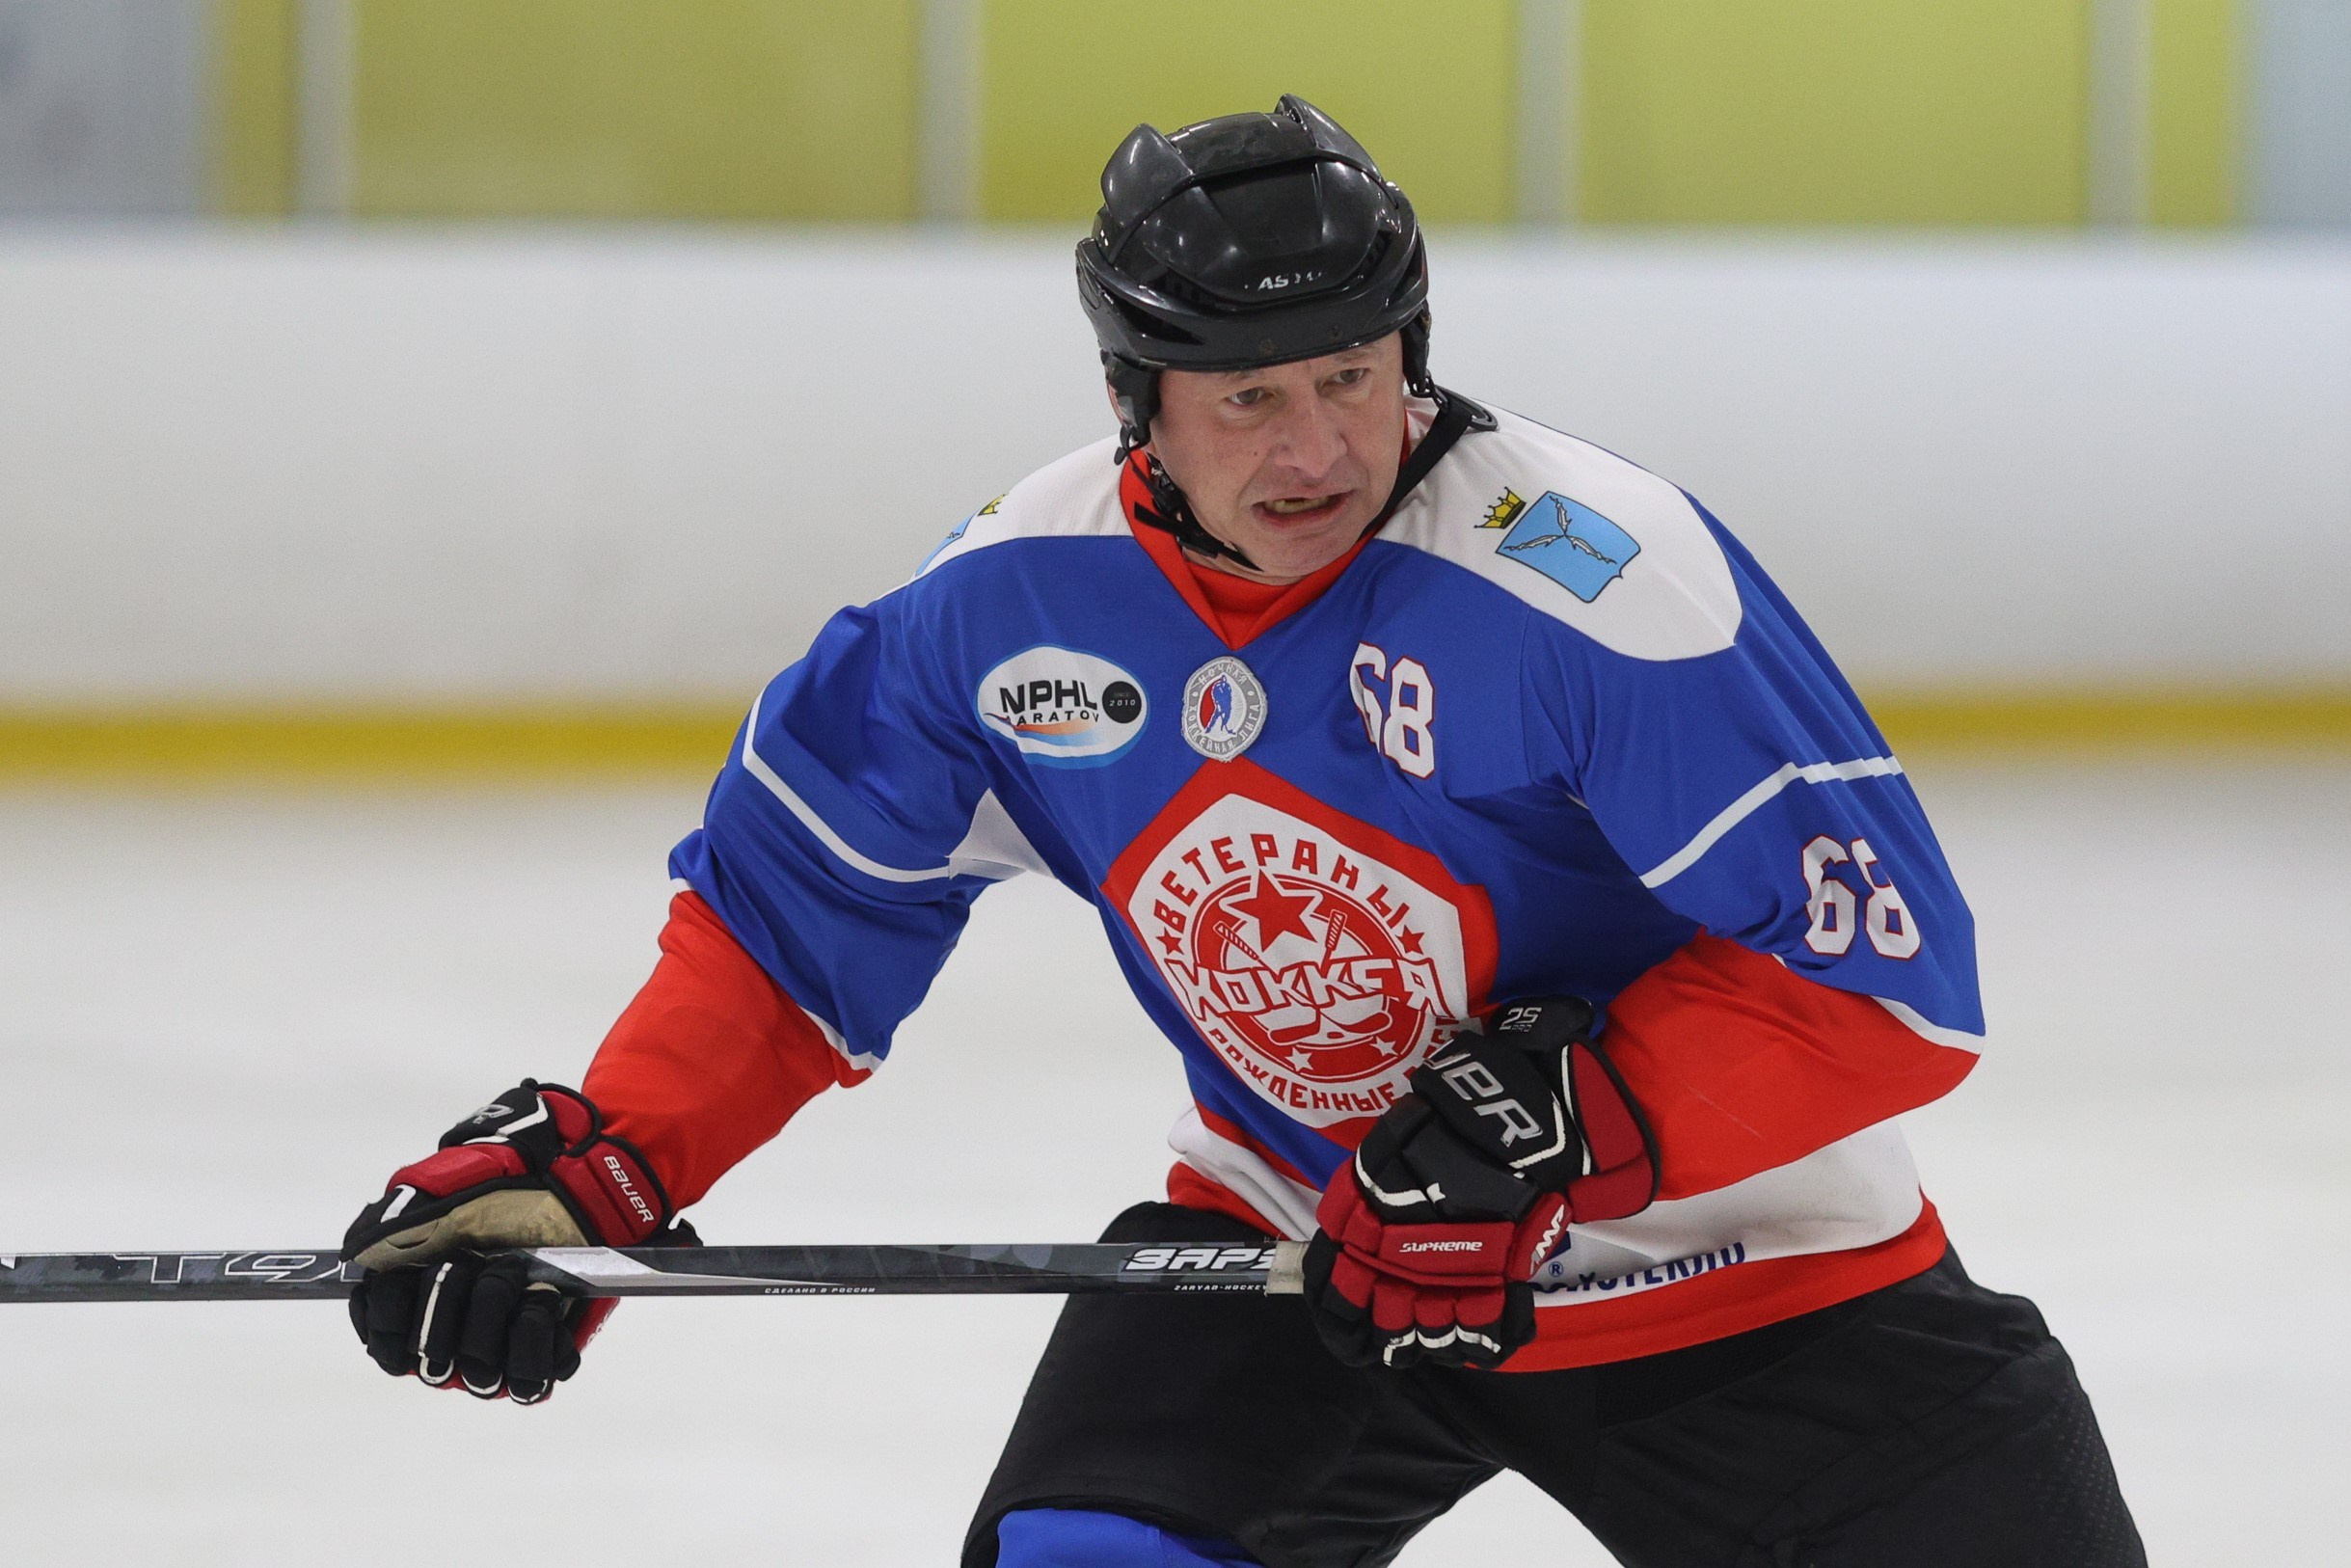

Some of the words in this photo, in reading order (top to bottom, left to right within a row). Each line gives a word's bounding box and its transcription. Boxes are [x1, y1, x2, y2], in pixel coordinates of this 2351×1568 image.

[1198, 663, 1248, 685] НОЧНАЯ
[999, 679, 1098, 716] NPHL
[1109, 698, 1137, 707] 2010
[1349, 640, 1435, 780] 68
[1006, 710, 1100, 727] ARATOV
[1239, 704, 1260, 741] ЛИГА
[1153, 832, 1411, 933] ВЕТЕРАНЫ
[1800, 834, 1922, 960] 68
[1208, 1027, 1397, 1113] РОЖДЕННЫЕ
